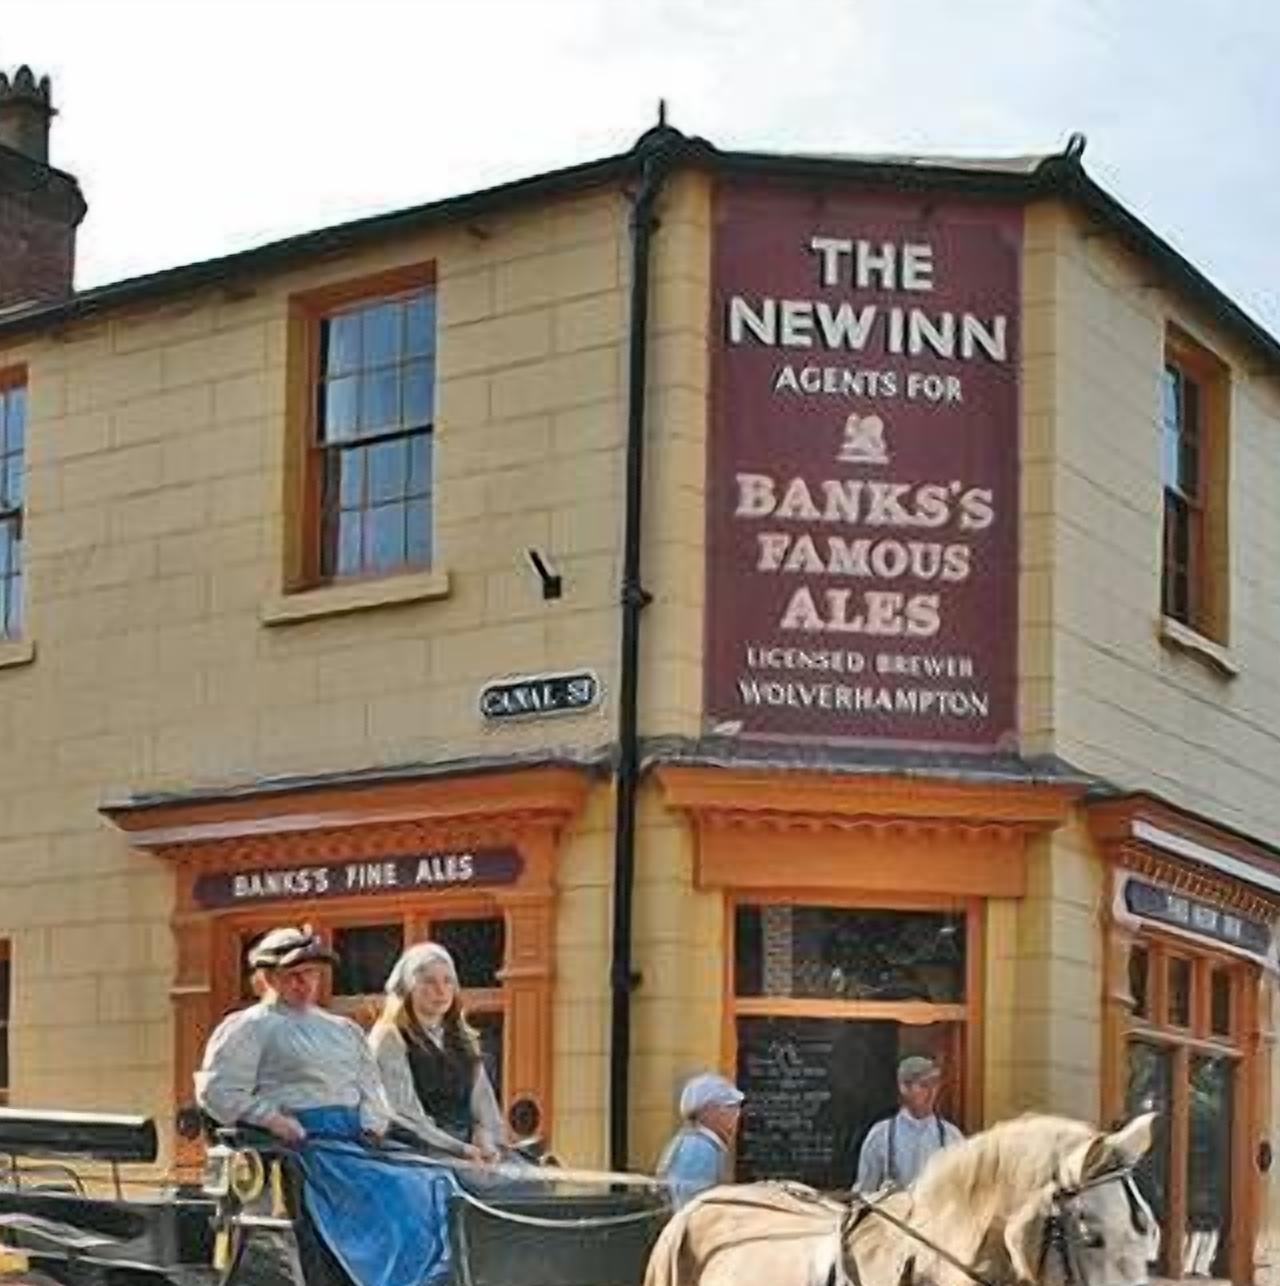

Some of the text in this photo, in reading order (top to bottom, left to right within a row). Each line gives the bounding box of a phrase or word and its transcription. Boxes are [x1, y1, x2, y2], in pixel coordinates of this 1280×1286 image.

[811, 237, 934, 291] THE
[728, 297, 1008, 362] NEW INN
[774, 366, 963, 402] AGENTS FOR
[734, 472, 995, 530] BANKS'S
[755, 532, 972, 582] FAMOUS
[779, 585, 941, 637] ALES
[746, 646, 866, 674] LICENSED
[737, 678, 990, 718] WOLVERHAMPTON
[233, 855, 474, 897] BANKS'S FINE ALES
